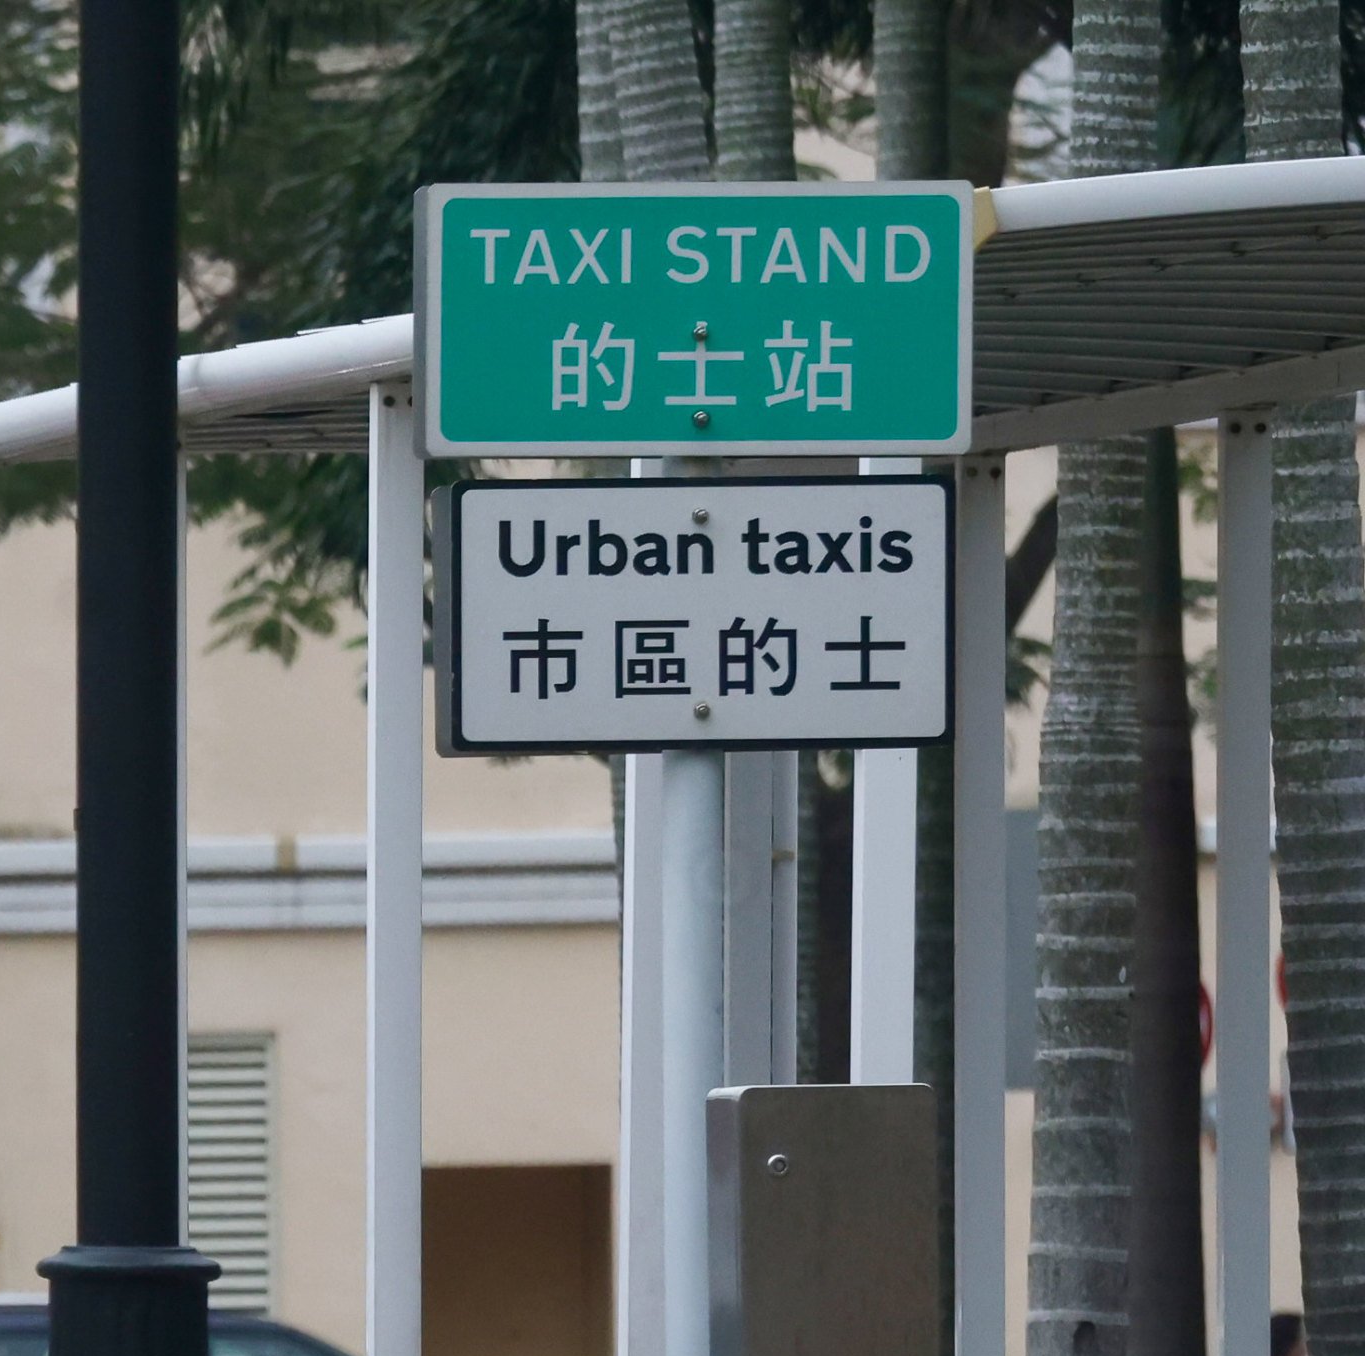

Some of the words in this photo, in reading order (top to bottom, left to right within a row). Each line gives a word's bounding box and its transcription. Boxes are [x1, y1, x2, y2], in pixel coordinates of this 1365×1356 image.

[469, 227, 633, 285] TAXI
[666, 225, 931, 284] STAND
[551, 320, 853, 412] 的士站
[497, 518, 715, 578] Urban
[741, 515, 914, 577] taxis
[502, 615, 907, 700] 市區的士
